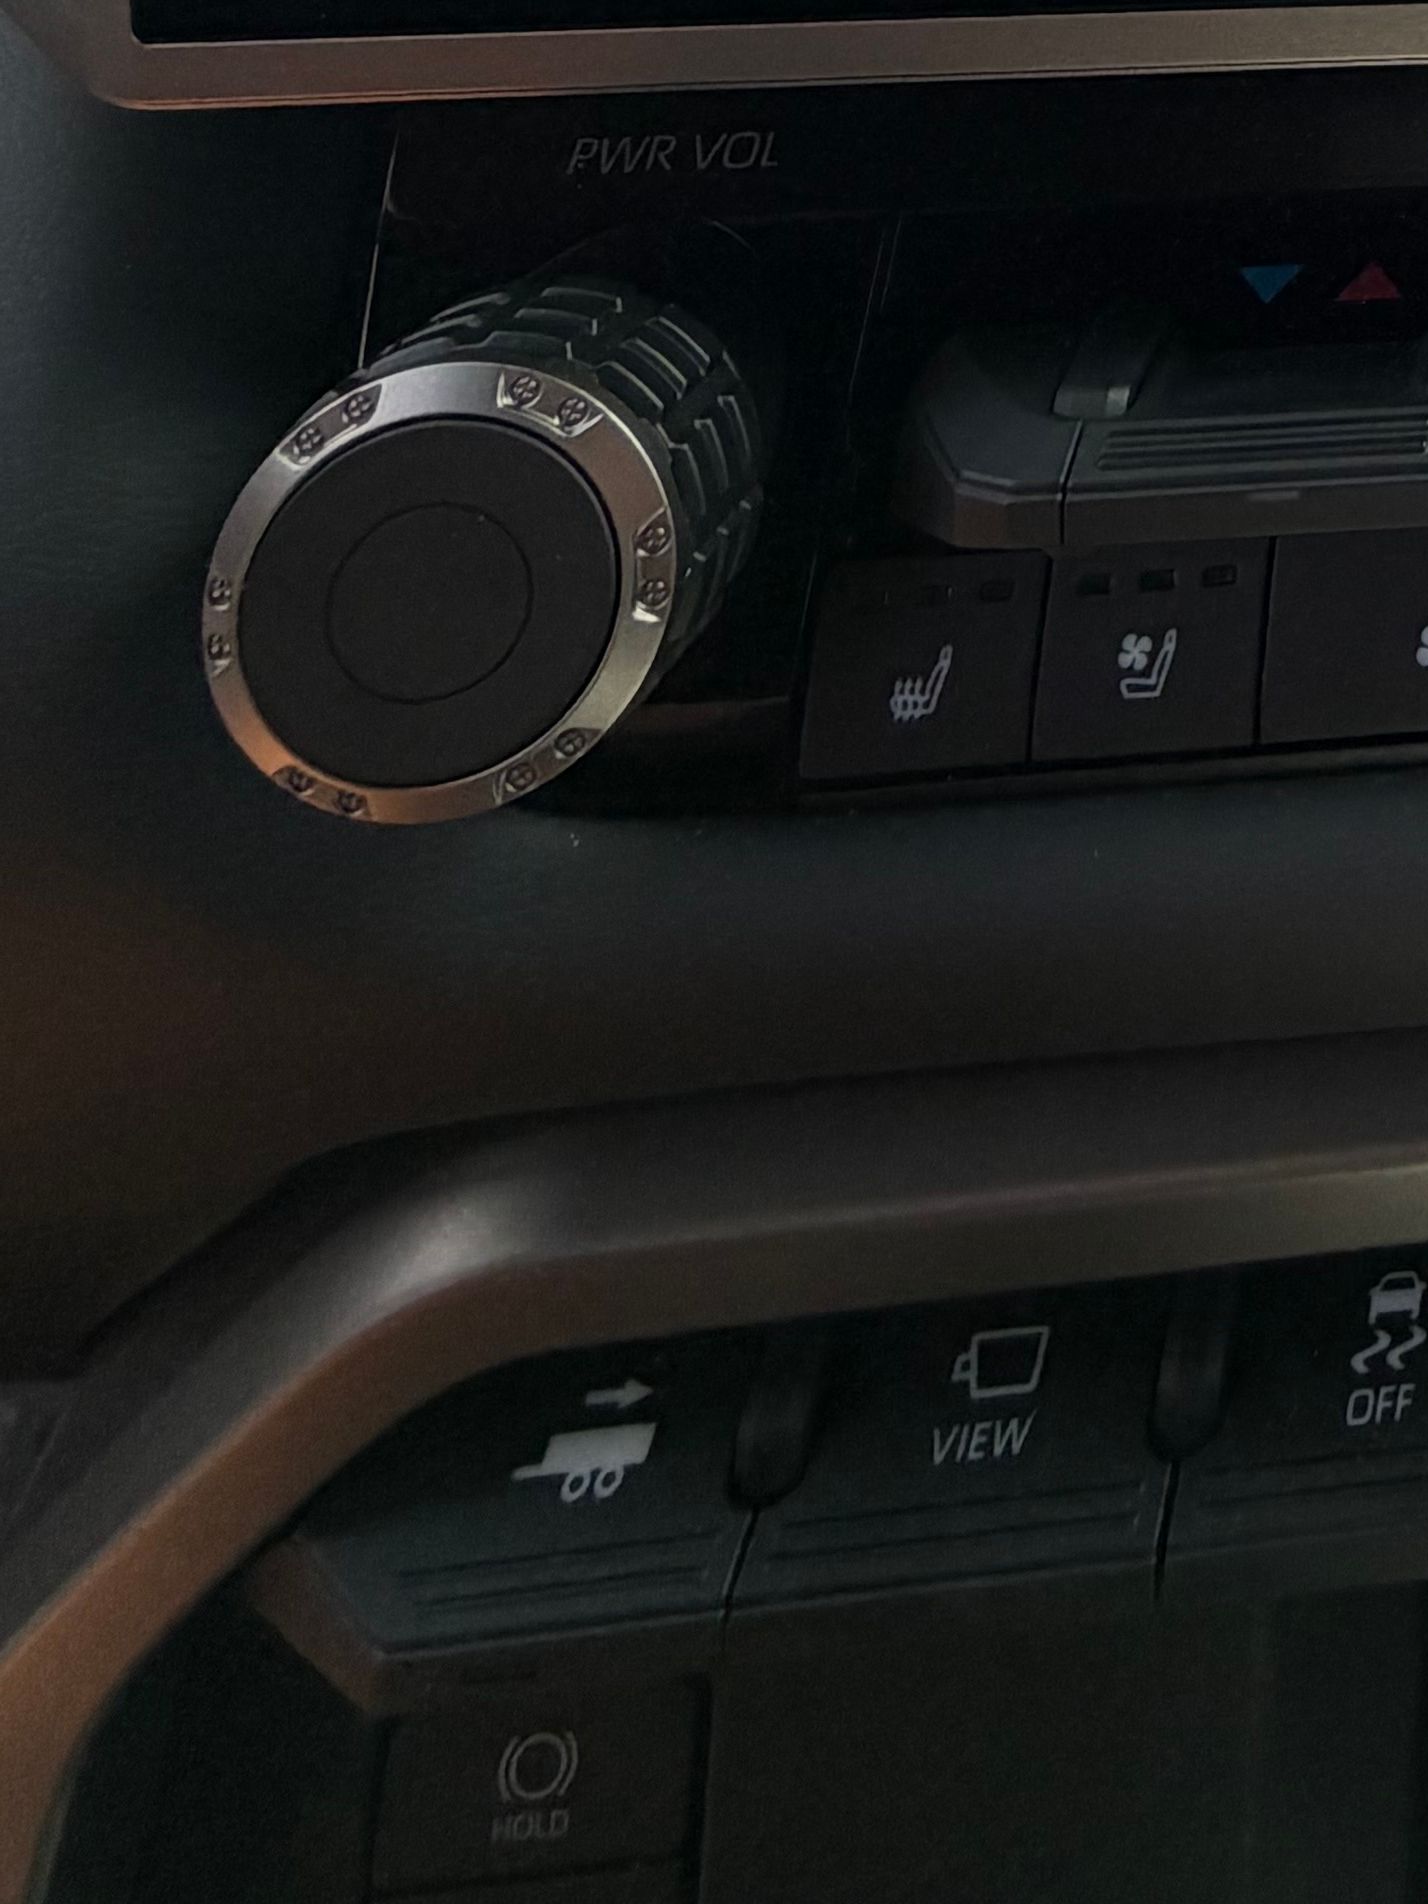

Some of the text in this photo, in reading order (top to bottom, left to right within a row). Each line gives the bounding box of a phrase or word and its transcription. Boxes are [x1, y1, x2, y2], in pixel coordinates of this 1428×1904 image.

[568, 129, 781, 176] PWR VOL
[1344, 1384, 1417, 1428] OFF
[932, 1411, 1033, 1466] VIEW
[490, 1808, 570, 1844] HOLD
